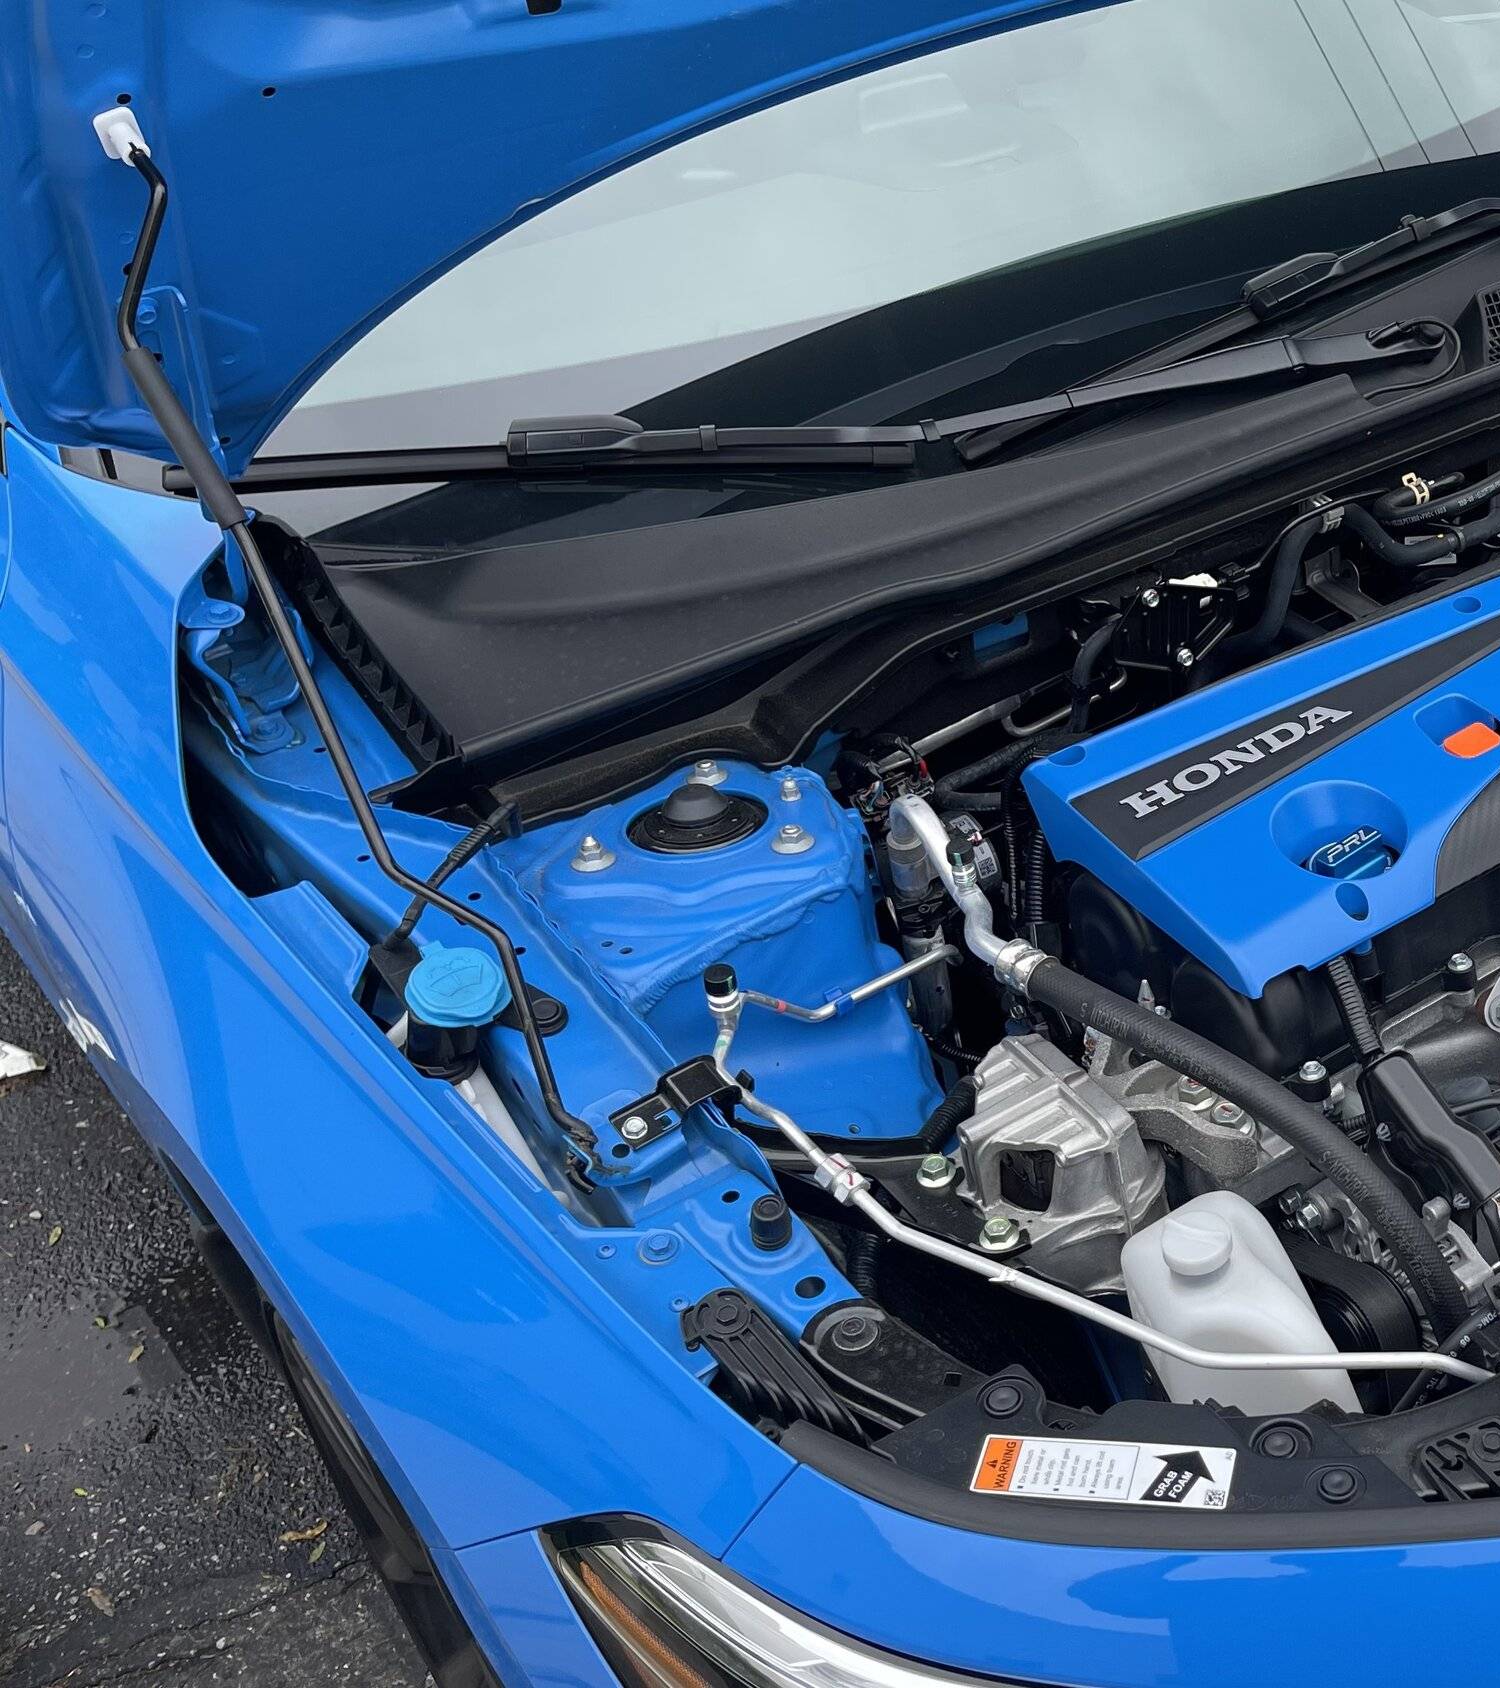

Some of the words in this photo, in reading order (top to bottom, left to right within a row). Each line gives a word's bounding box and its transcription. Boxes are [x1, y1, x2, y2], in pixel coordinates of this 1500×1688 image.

[1118, 706, 1353, 819] HONDA
[1326, 829, 1378, 863] PRL
[993, 1441, 1017, 1489] WARNING
[1153, 1470, 1178, 1498] GRAB
[1168, 1470, 1194, 1499] FOAM
